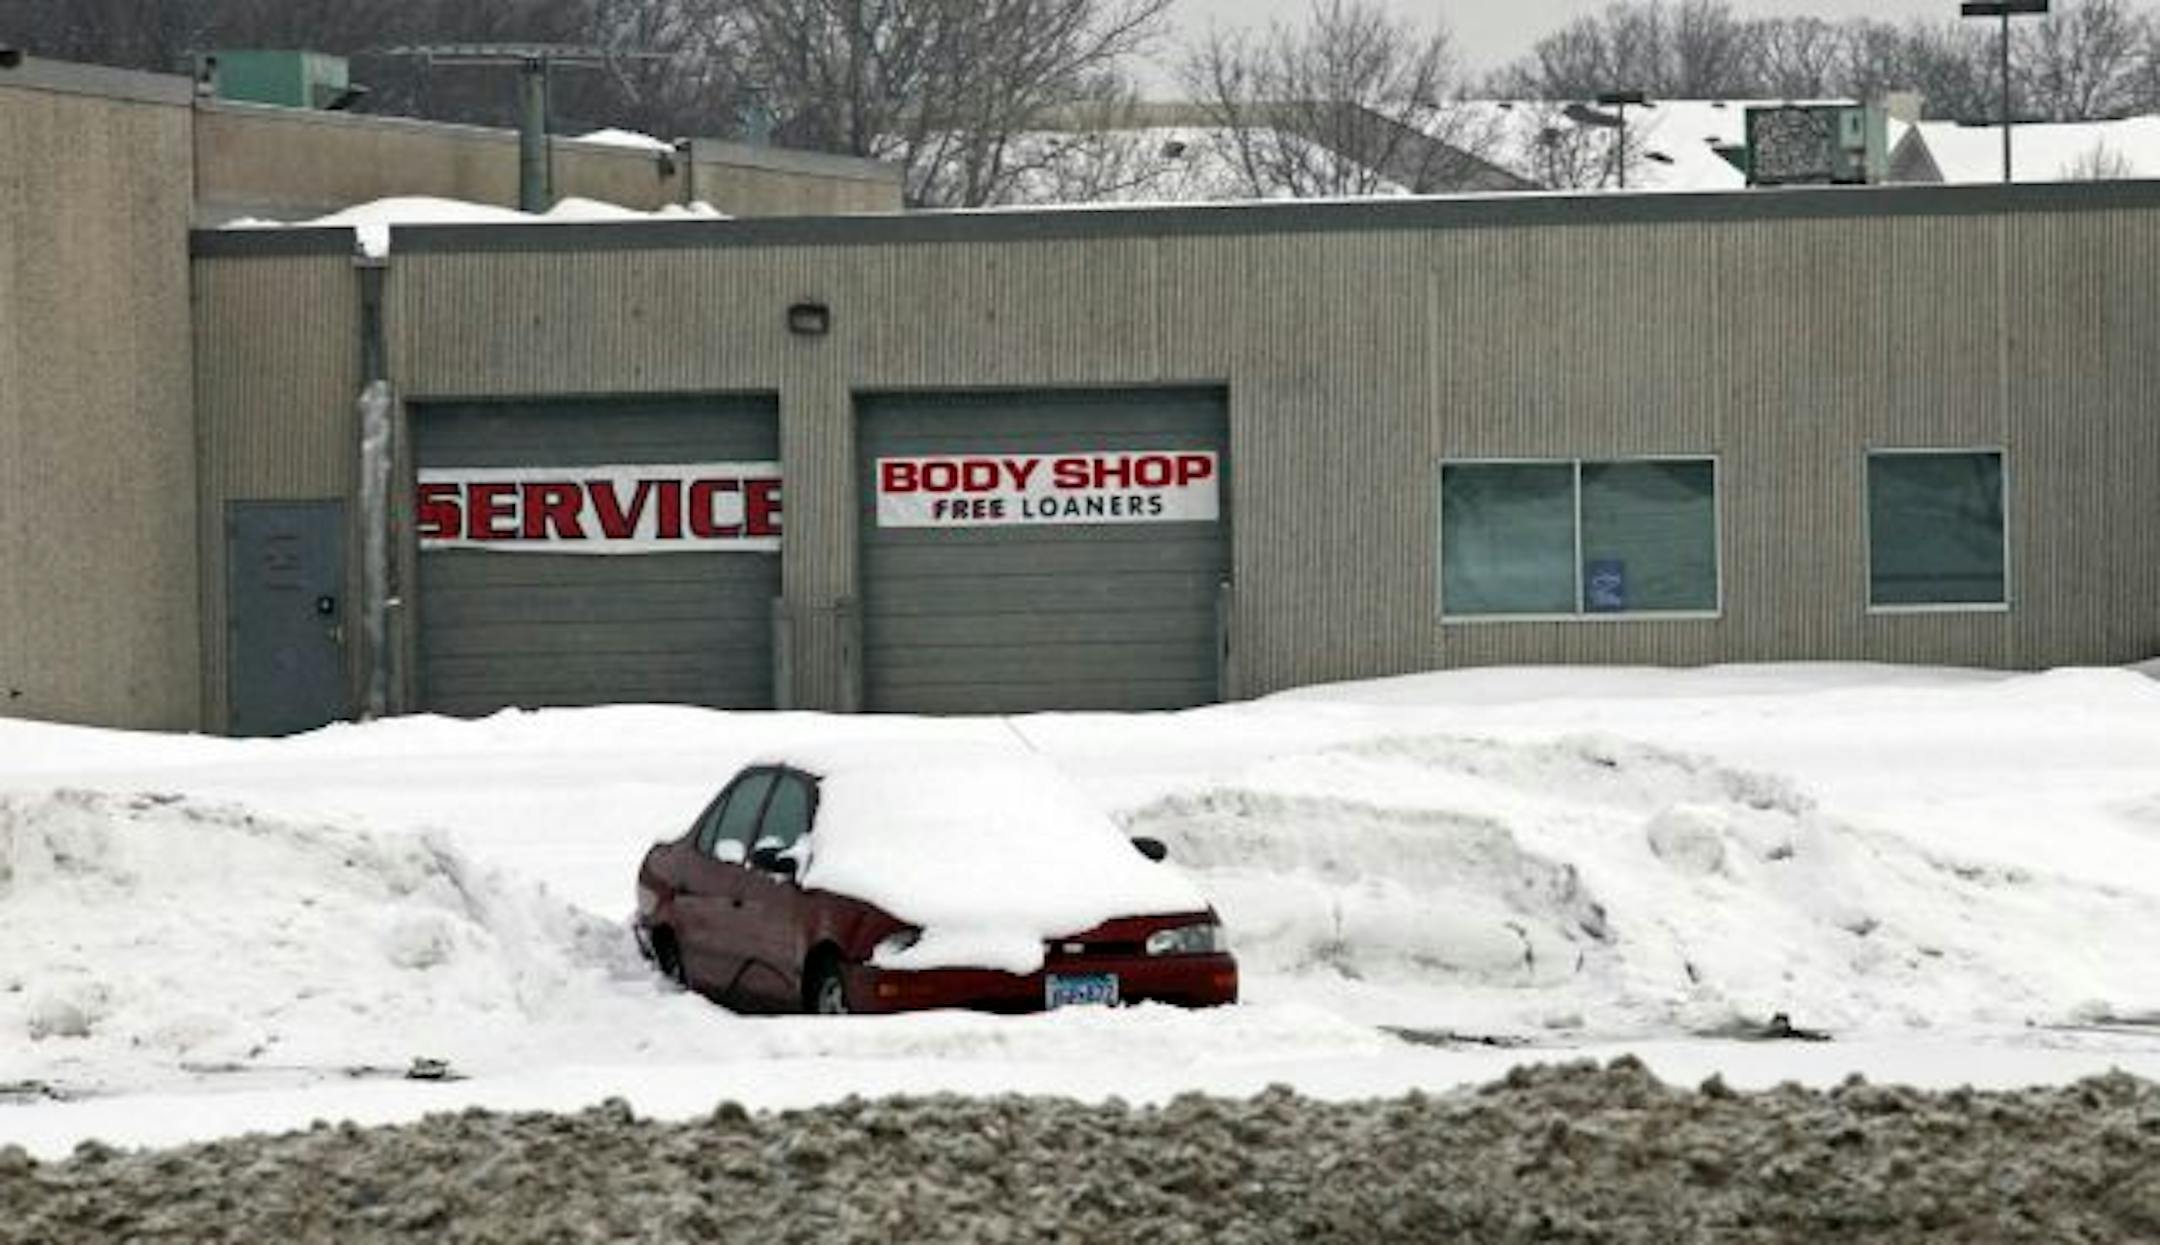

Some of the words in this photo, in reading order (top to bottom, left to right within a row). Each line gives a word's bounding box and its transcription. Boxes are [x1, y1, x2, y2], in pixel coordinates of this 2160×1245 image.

[882, 458, 1039, 492] BODY
[1054, 456, 1213, 489] SHOP
[417, 479, 782, 540] SERVICE
[933, 499, 1005, 519] FREE
[1022, 495, 1163, 518] LOANERS
